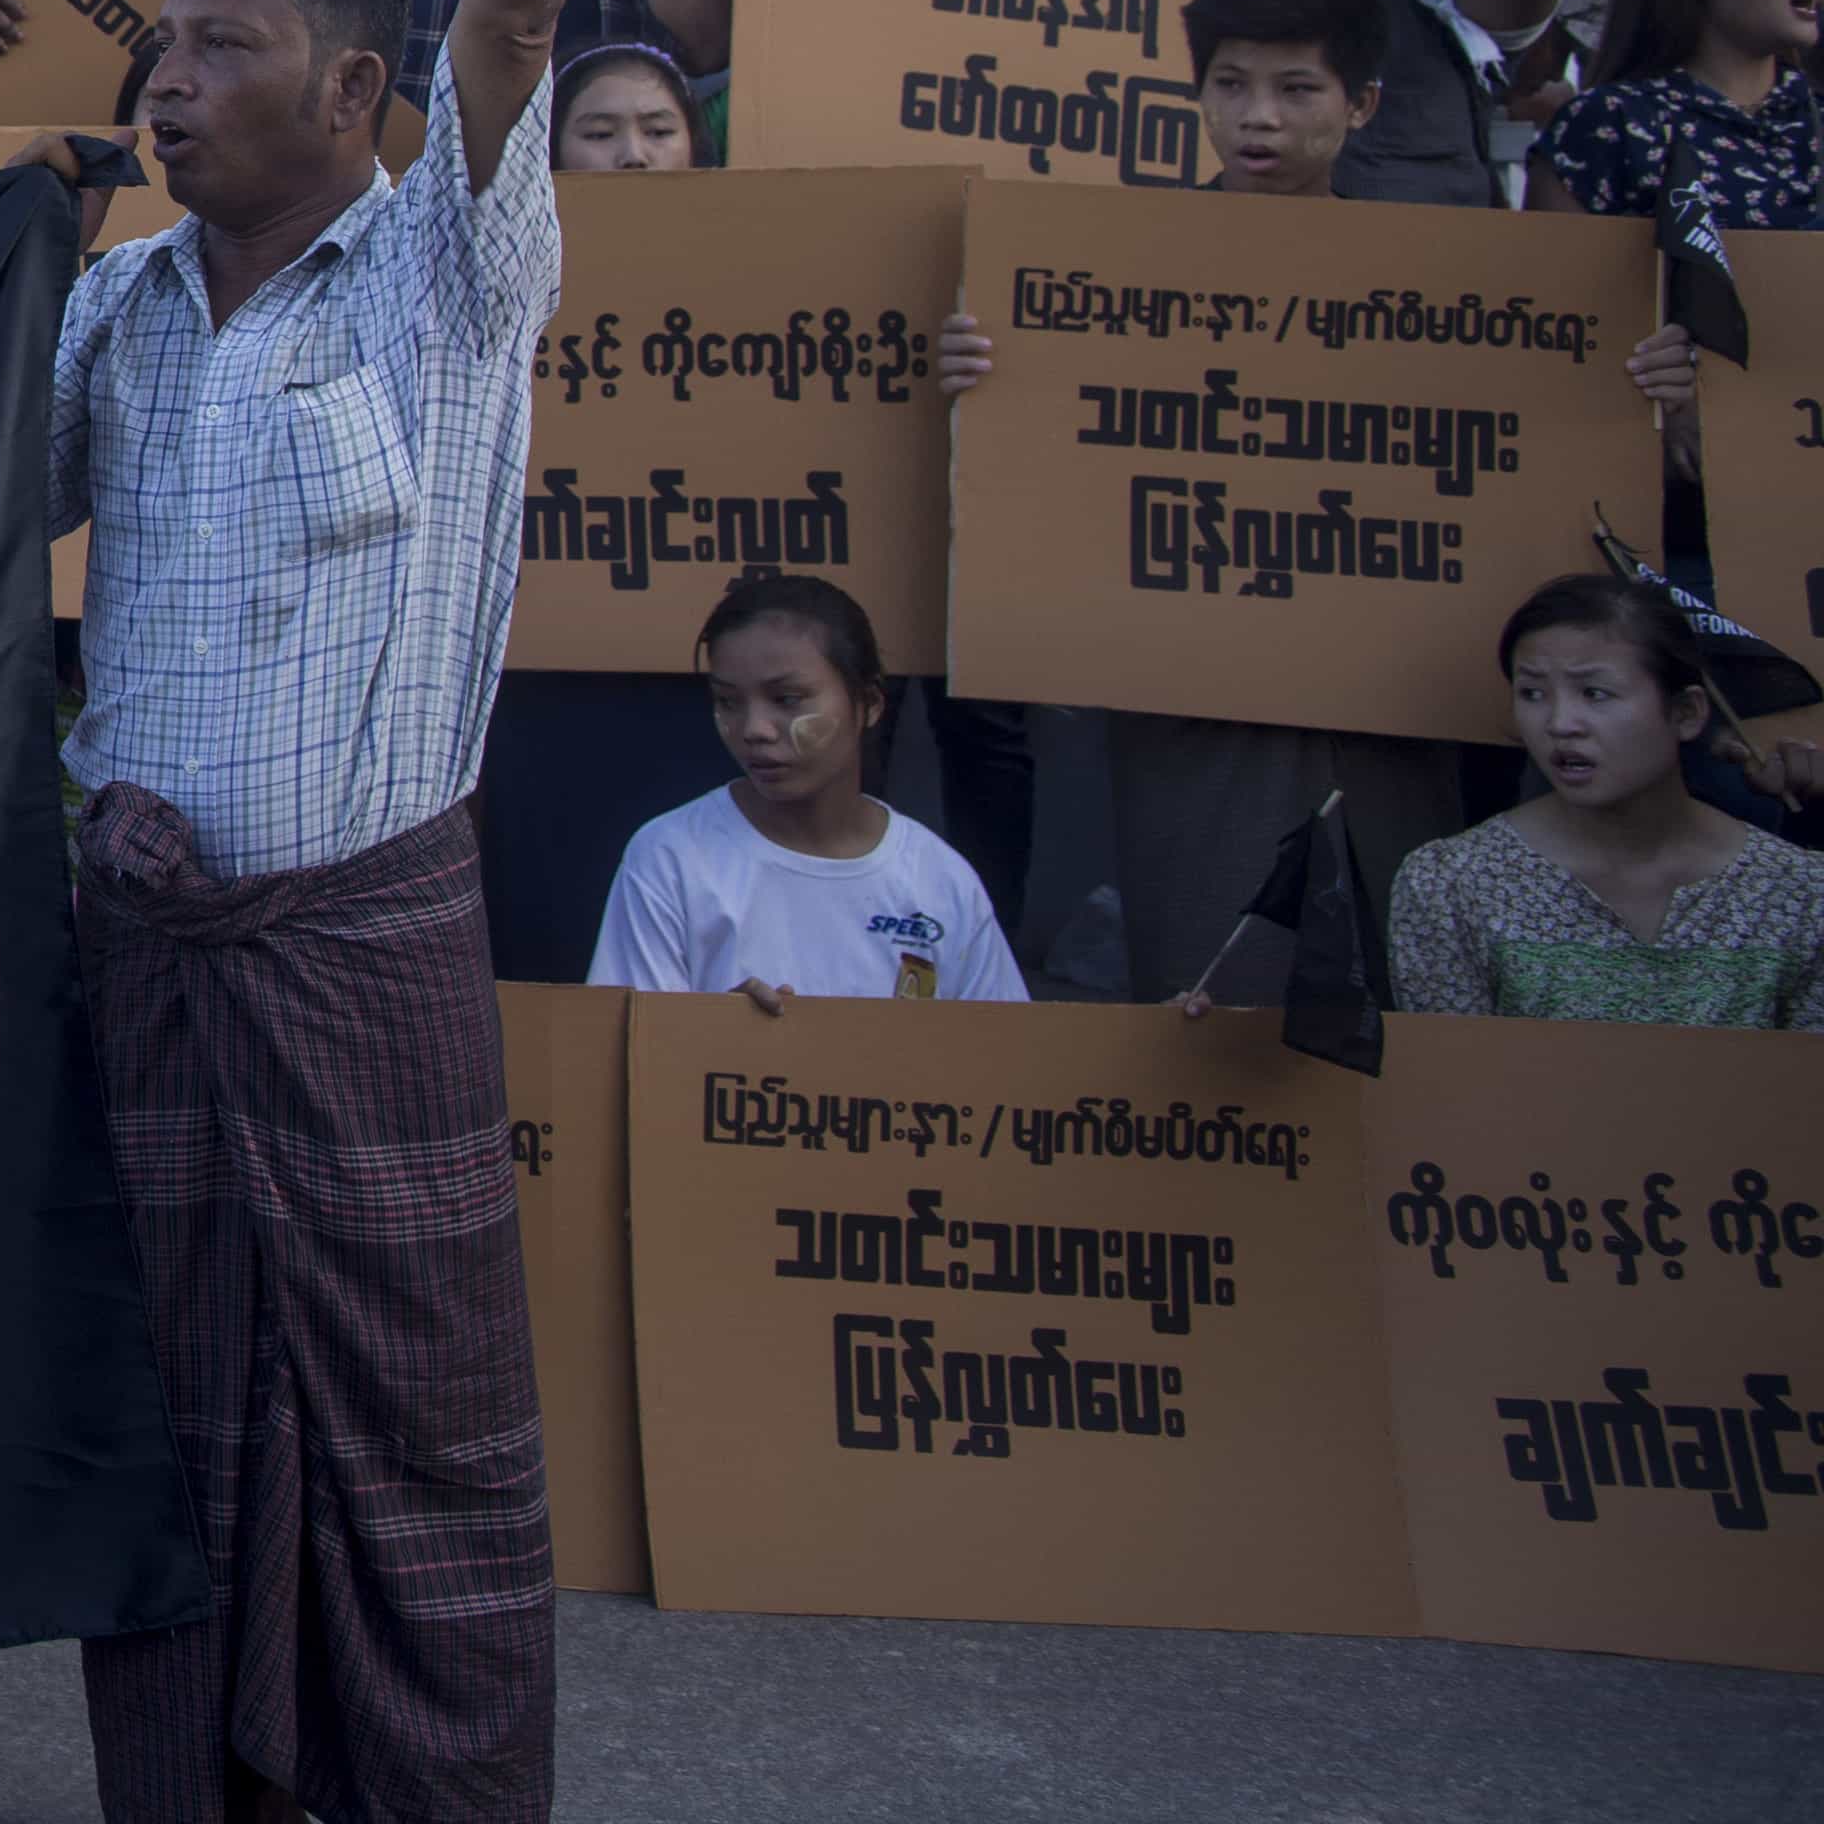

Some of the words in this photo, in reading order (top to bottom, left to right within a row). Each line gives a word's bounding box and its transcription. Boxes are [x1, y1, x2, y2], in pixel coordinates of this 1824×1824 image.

[1076, 369, 1520, 497] သတင်းသမားများ
[774, 1188, 1237, 1336] သတင်းသမားများ
